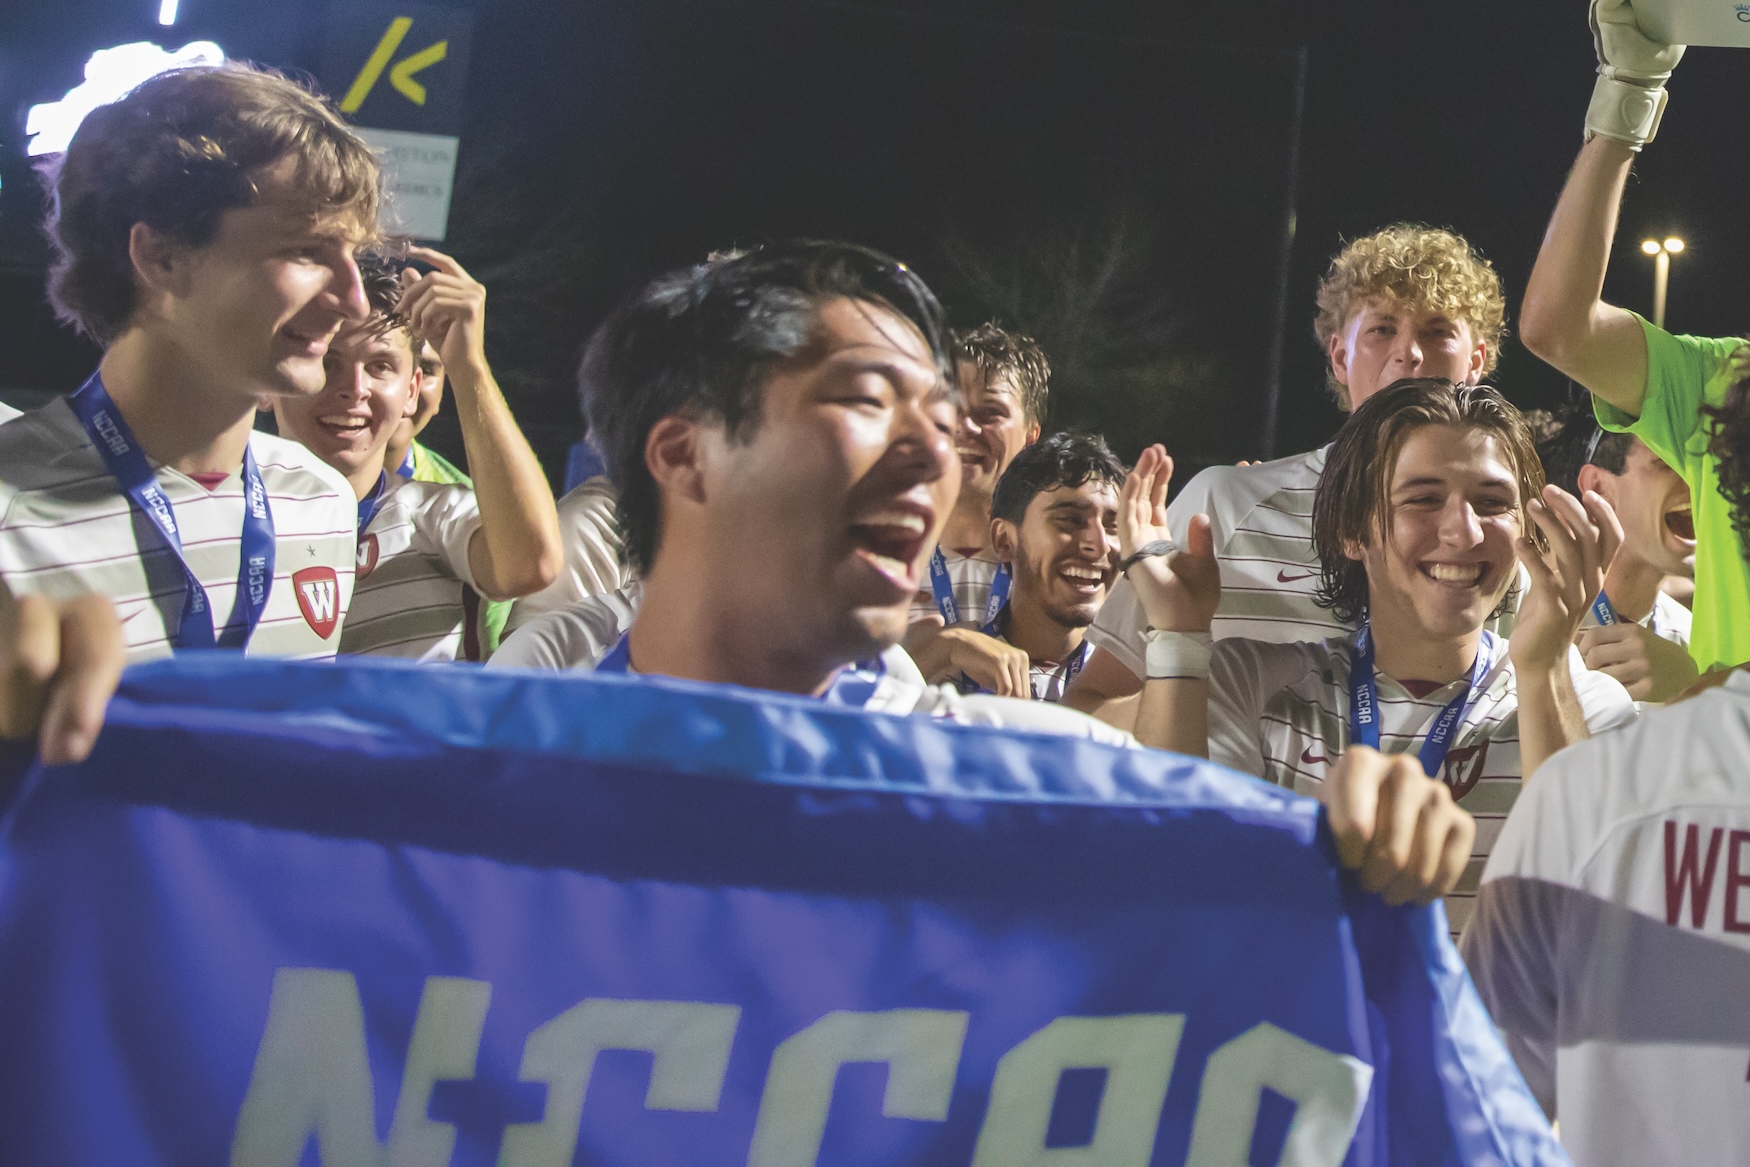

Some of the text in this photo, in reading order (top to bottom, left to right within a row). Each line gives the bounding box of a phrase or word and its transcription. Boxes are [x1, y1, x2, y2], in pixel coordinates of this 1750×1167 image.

[91, 410, 130, 456] NCCAA
[141, 485, 177, 534] NCCAA
[251, 474, 267, 521] NCCAA
[251, 556, 267, 607] NCCAA
[302, 580, 336, 622] W
[1356, 683, 1373, 725] NCCAA
[1431, 706, 1459, 744] NCCAA
[230, 966, 1375, 1167] NCCAA
